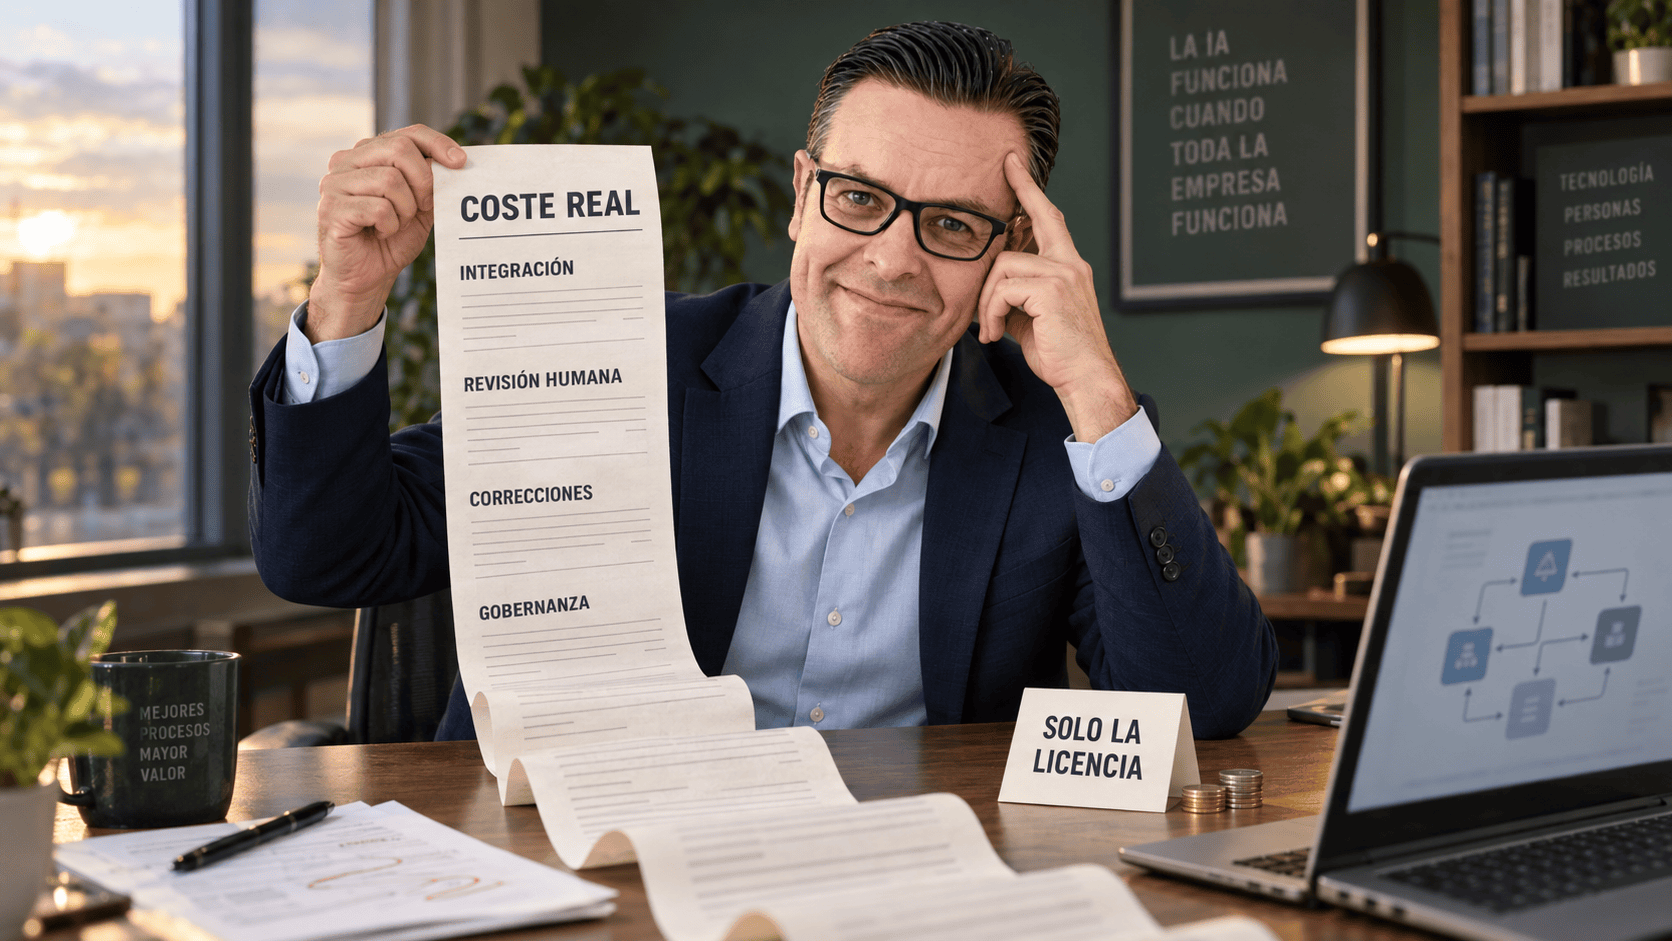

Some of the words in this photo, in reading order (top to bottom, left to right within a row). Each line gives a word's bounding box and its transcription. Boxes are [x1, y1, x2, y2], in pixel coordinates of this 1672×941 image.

[1170, 34, 1198, 60] LA
[1207, 29, 1230, 57] IA
[1171, 58, 1288, 96] FUNCIONA
[1170, 96, 1265, 129] CUANDO
[1170, 136, 1232, 166] TODA
[1240, 132, 1269, 159] LA
[1171, 167, 1281, 201] EMPRESA
[1560, 161, 1654, 191] TECNOLOGÍA
[461, 192, 556, 223] COSTE
[567, 189, 641, 218] REAL
[1172, 201, 1288, 236] FUNCIONA
[1565, 198, 1641, 223] PERSONAS
[1564, 230, 1641, 257] PROCESOS
[460, 257, 574, 281] INTEGRACIÓN
[1563, 260, 1656, 289] RESULTADOS
[464, 370, 540, 392] REVISIÓN
[546, 368, 622, 387] HUMANA
[469, 484, 593, 507] CORRECCIONES
[479, 595, 590, 621] GOBERNANZA
[139, 702, 204, 721] MEJORES
[139, 722, 210, 741] PROCESOS
[1042, 715, 1103, 742] SOLO
[1111, 718, 1141, 744] LA
[139, 745, 188, 762] MAYOR
[1033, 748, 1142, 780] LICENCIA
[140, 766, 186, 782] VALOR
